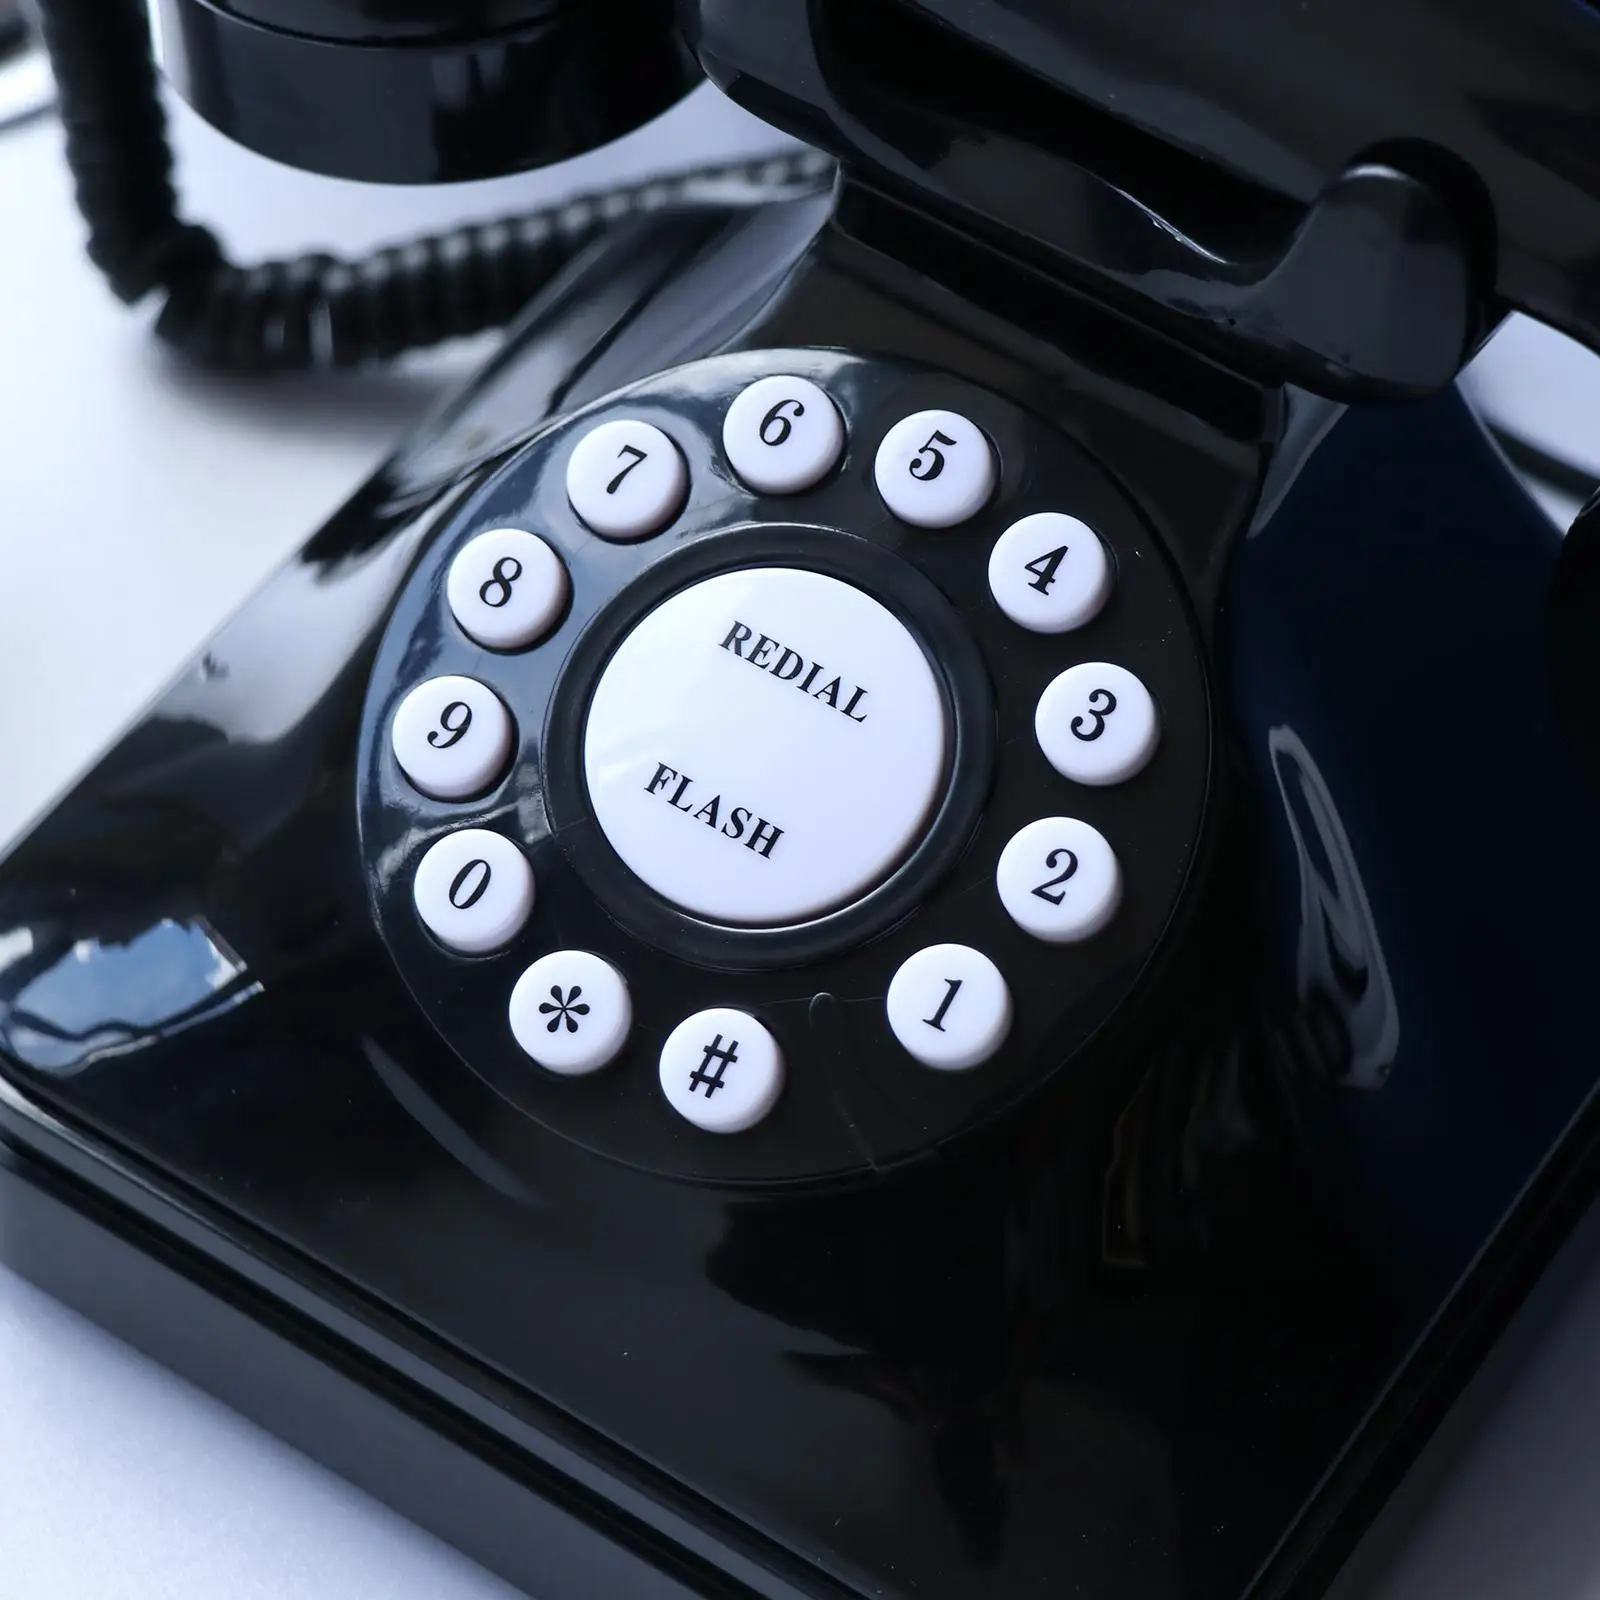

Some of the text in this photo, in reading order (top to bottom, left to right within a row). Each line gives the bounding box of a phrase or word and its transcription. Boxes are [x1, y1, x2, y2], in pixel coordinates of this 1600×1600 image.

[759, 399, 805, 447] 6
[606, 444, 648, 495] 7
[908, 429, 958, 482] 5
[478, 556, 523, 608] 8
[1024, 545, 1069, 596] 4
[719, 620, 869, 725] REDIAL
[426, 701, 473, 749] 9
[1070, 688, 1118, 742] 3
[643, 762, 785, 860] FLASH
[448, 858, 492, 910] 0
[1030, 848, 1079, 906] 2
[922, 978, 963, 1033] 1
